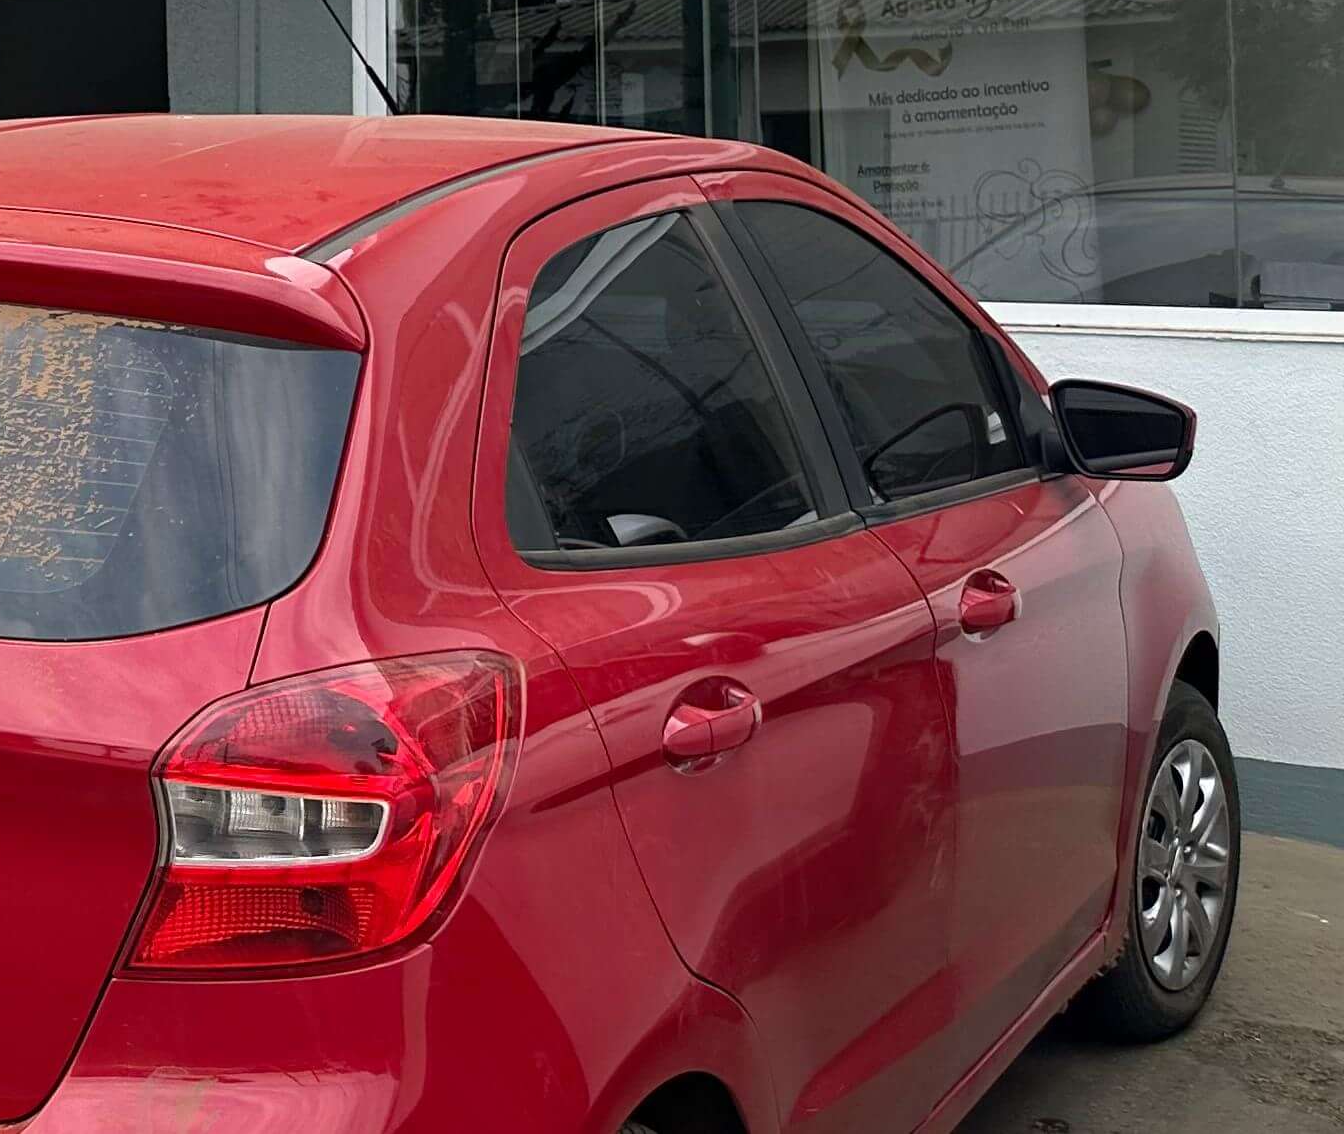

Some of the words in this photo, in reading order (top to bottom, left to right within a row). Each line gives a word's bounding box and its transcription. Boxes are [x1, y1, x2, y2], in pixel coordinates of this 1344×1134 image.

[896, 86, 958, 104] dedicado
[962, 86, 980, 98] ao
[914, 103, 1018, 123] amamentação
